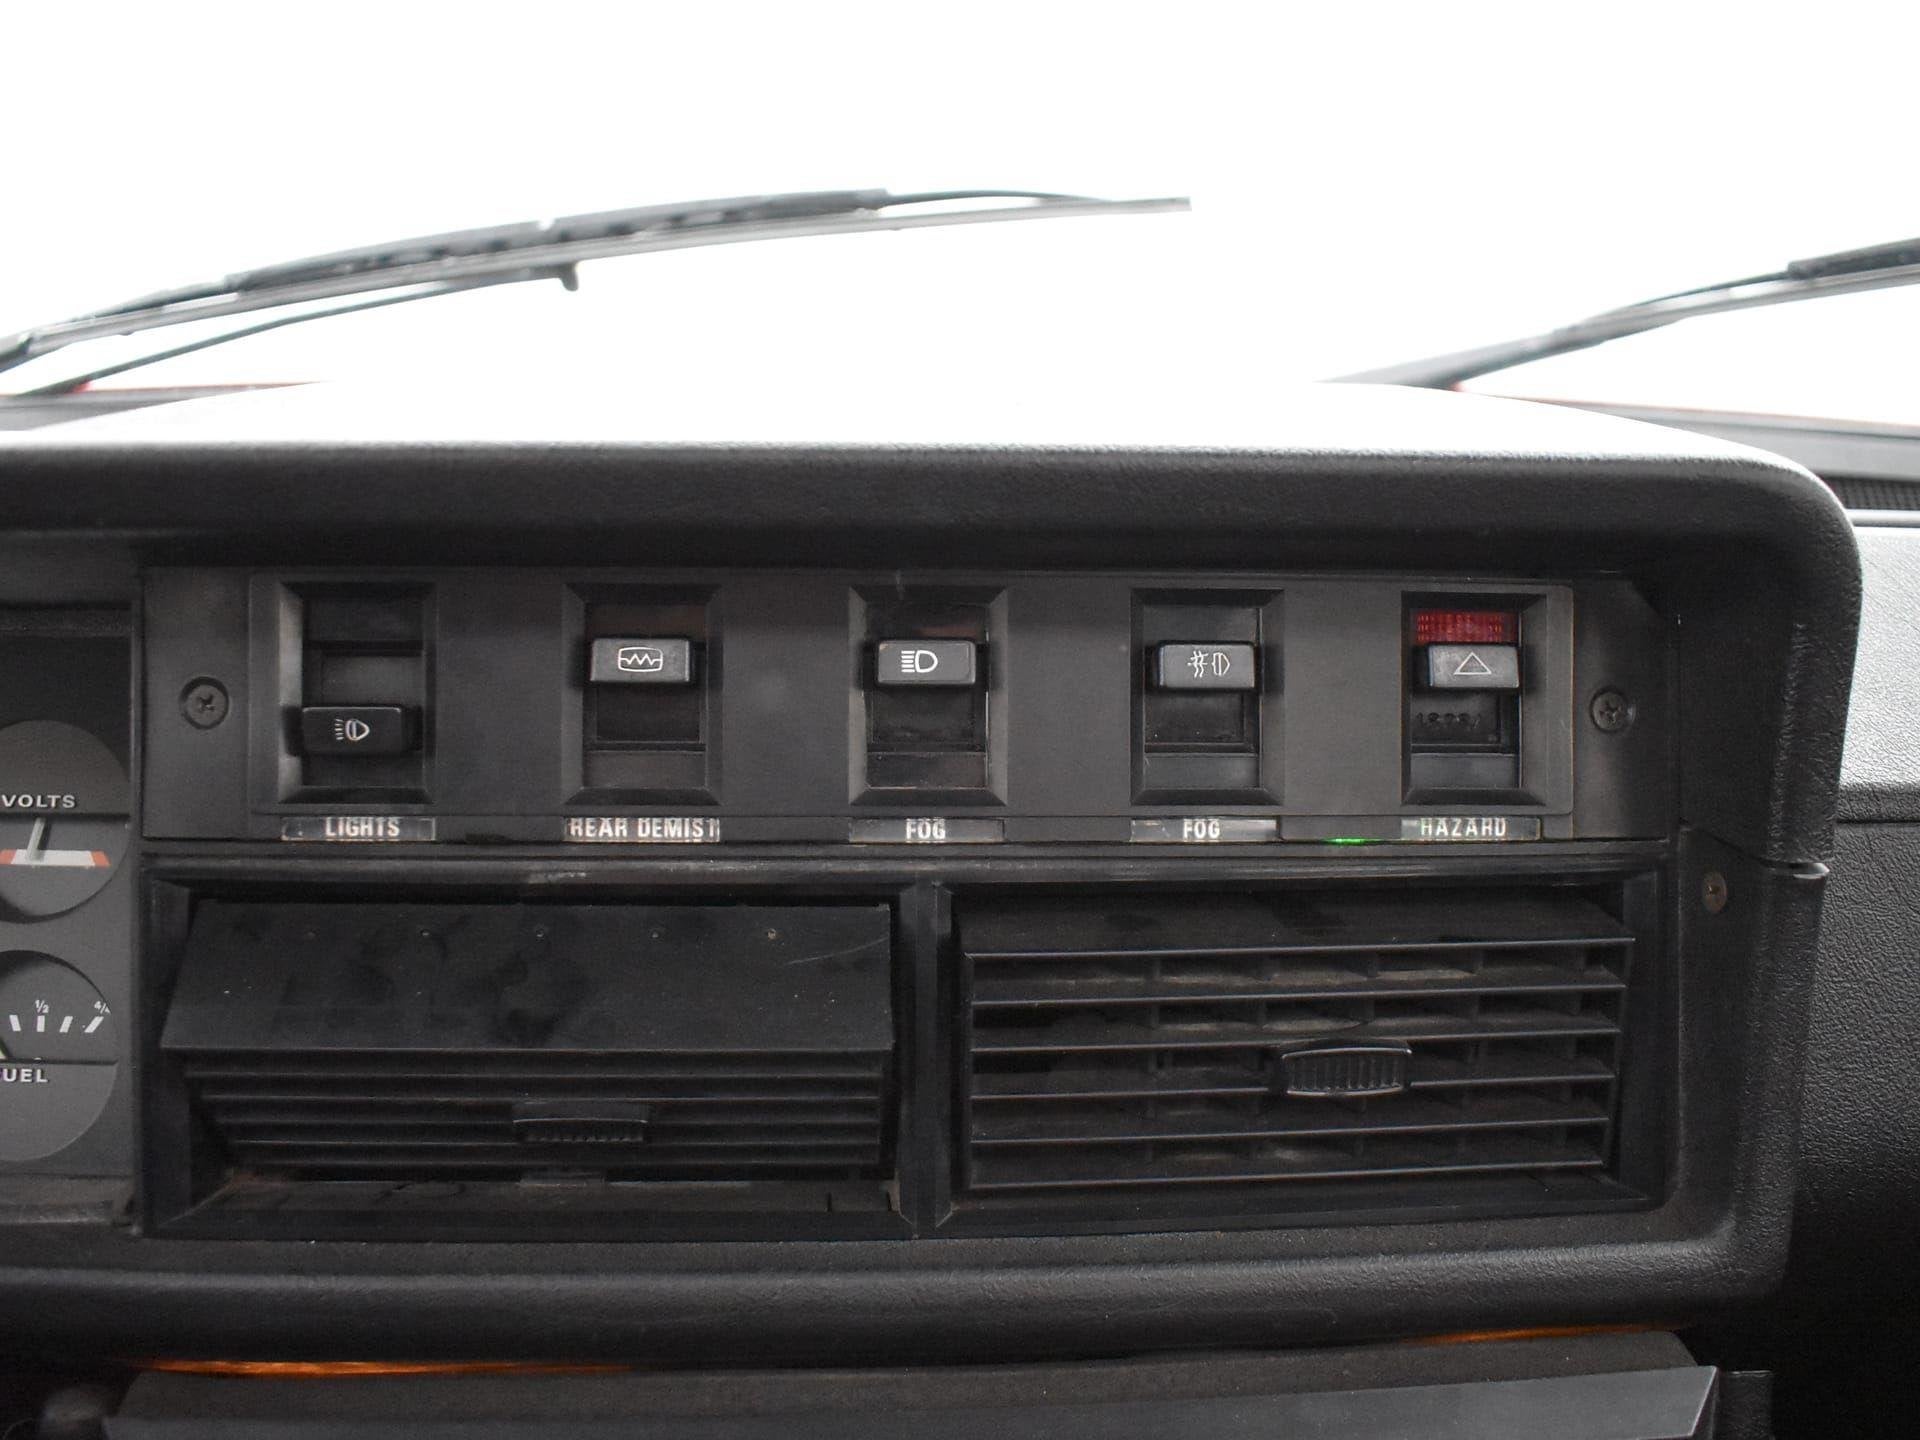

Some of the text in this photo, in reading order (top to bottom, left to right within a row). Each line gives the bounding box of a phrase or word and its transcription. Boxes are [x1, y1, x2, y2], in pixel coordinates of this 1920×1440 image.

[1, 794, 76, 808] VOLTS
[325, 817, 400, 837] LIGHTS
[570, 818, 717, 838] REAR DEMIST
[906, 818, 946, 840] FOG
[1183, 818, 1221, 839] FOG
[1420, 817, 1507, 837] HAZARD
[0, 1068, 48, 1082] UEL
